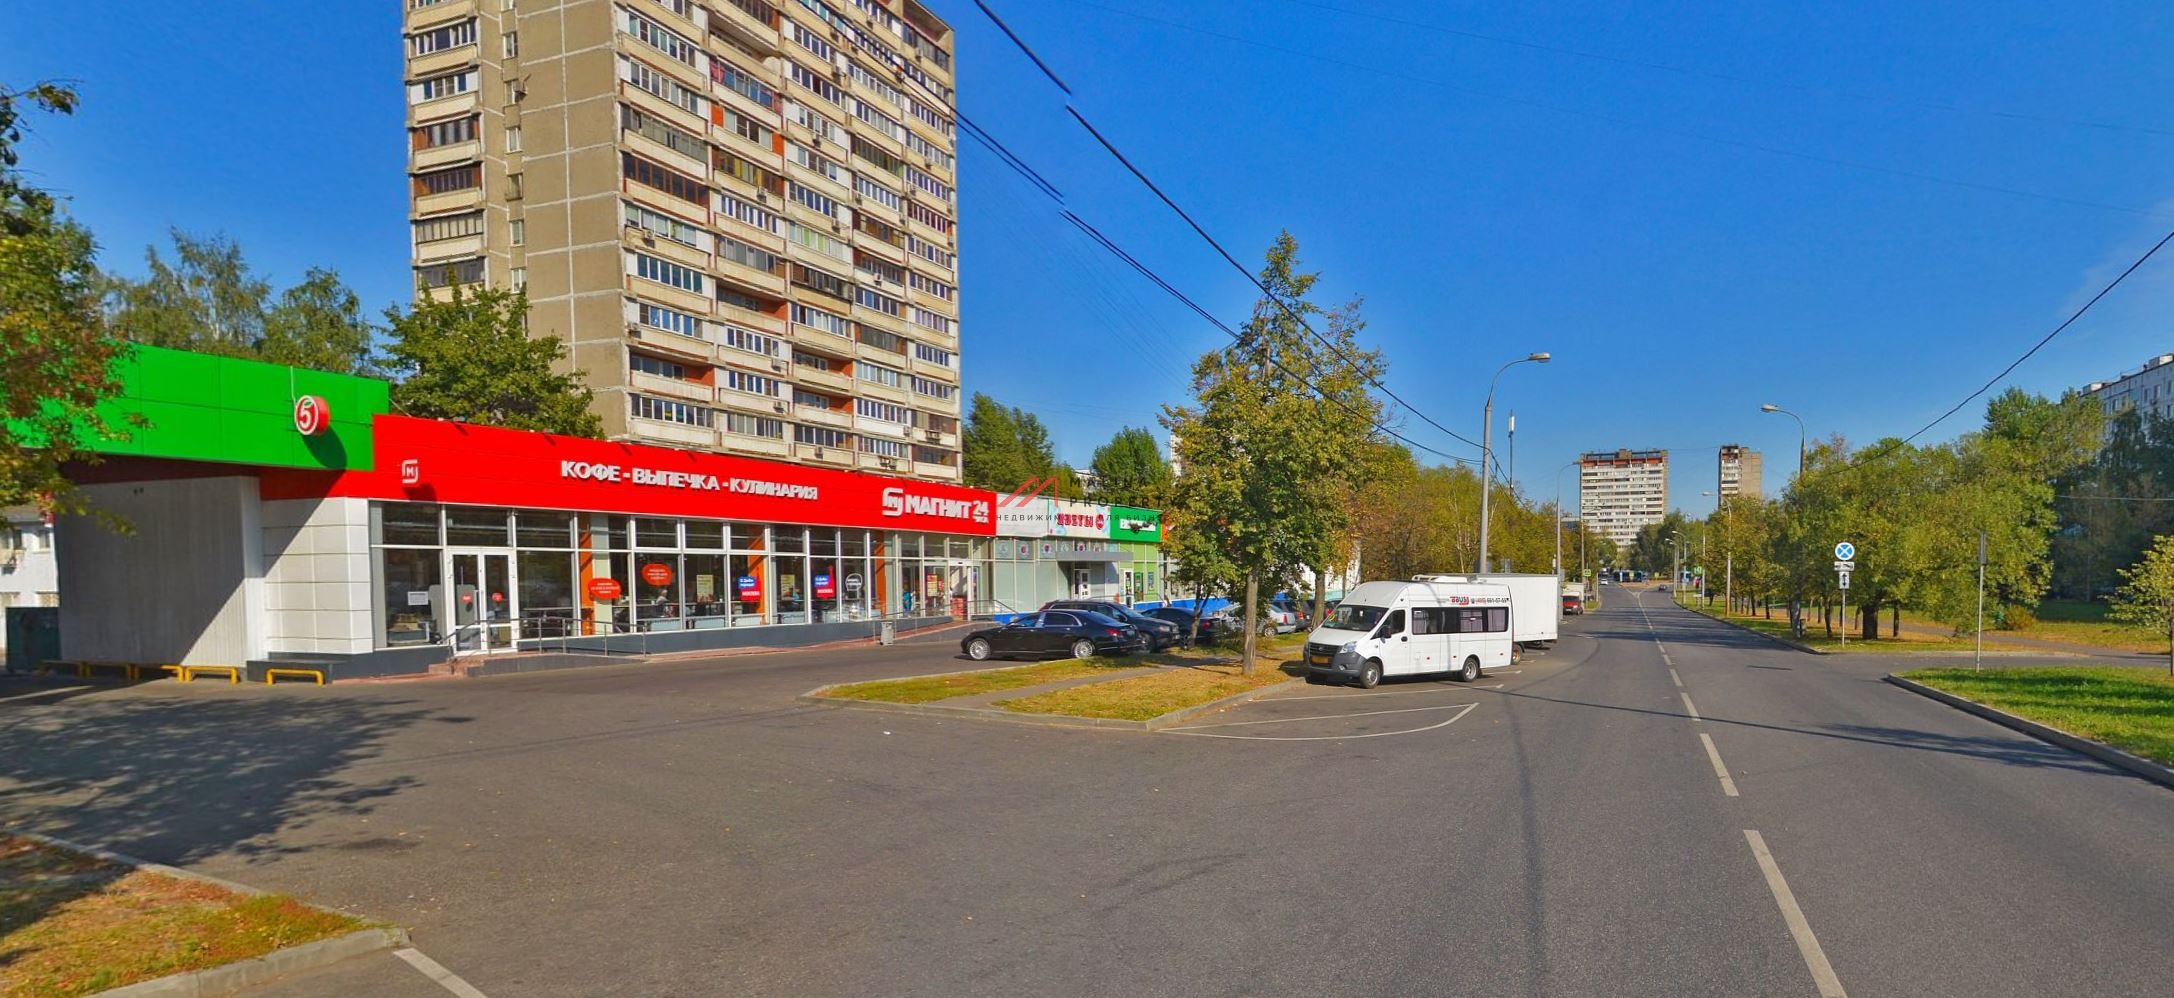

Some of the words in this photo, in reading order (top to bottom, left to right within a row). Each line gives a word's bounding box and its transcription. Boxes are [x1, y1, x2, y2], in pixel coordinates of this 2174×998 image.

[561, 460, 622, 482] КОФЕ
[632, 468, 720, 491] ВЫПЕЧКА
[729, 477, 819, 500] КУЛИНАРИЯ
[905, 494, 972, 519] МАГНИТ
[972, 499, 990, 516] 24
[1057, 513, 1093, 528] ЦВЕТЫ
